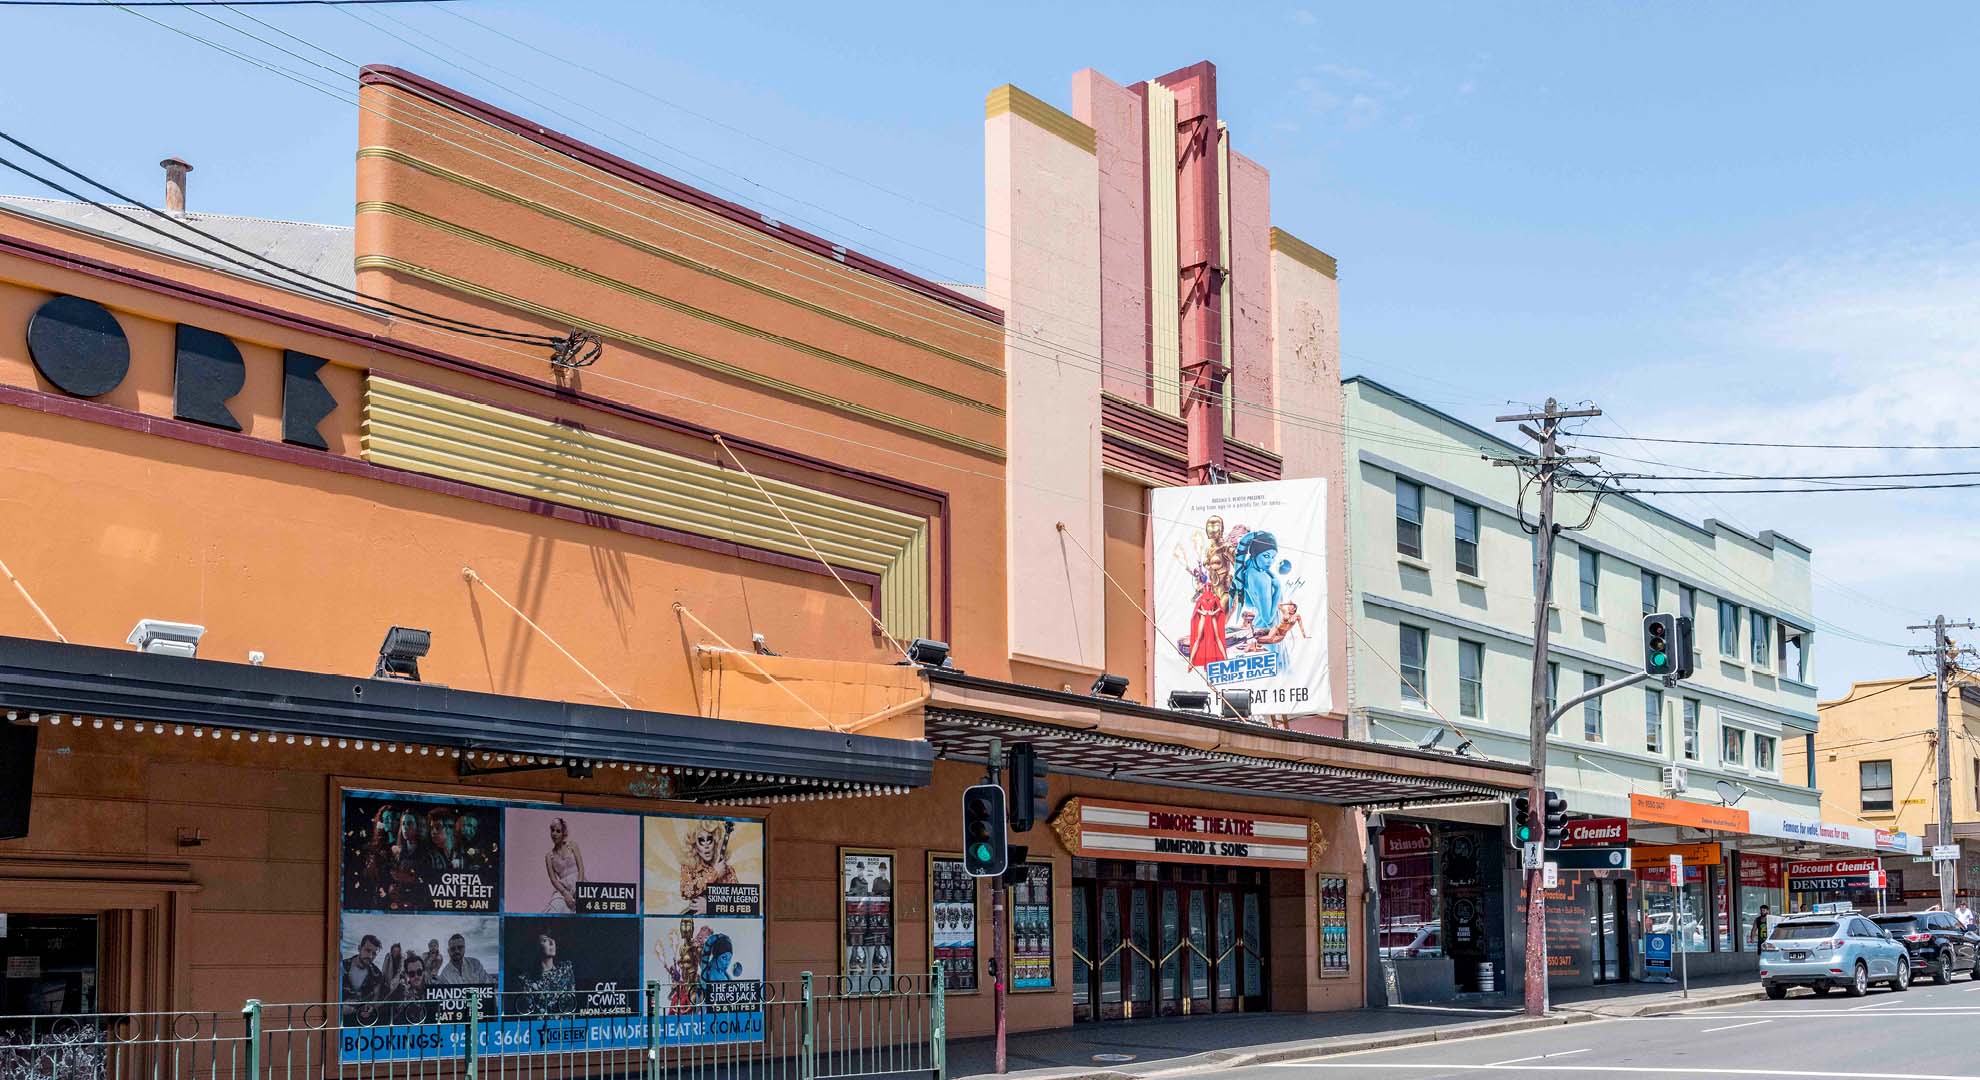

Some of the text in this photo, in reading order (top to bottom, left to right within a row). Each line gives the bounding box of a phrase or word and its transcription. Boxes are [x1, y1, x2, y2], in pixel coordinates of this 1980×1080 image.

[1208, 654, 1275, 677] EMPIRE
[1208, 667, 1277, 684] STRIPS BACK
[1250, 688, 1309, 704] SAT 16 FEB
[1149, 811, 1254, 837] ENMORE THEATRE
[1783, 820, 1799, 833] Famous
[1573, 825, 1622, 840] Chemist
[1155, 837, 1248, 857] MUMFORD & SONS
[1792, 861, 1875, 874] Discount Chemist
[441, 873, 482, 886] GRETA
[1792, 878, 1846, 890] DENTIST
[428, 884, 494, 898] VAN FLEET
[578, 886, 635, 899] LILY ALLEN
[707, 886, 759, 896] TRIXIE MATTEL
[433, 899, 489, 909] TUE 29 JAN
[585, 901, 626, 910] 4 & 5 FEB
[736, 905, 751, 913] FEB
[426, 987, 493, 1000] HANDSIKE
[595, 982, 617, 994] CAT
[711, 983, 726, 992] THE
[710, 992, 735, 1002] STRIPS
[439, 999, 484, 1010] HOUS
[435, 1012, 454, 1021] SAT
[456, 1012, 463, 1021] 9
[344, 1030, 530, 1051] BOOKINGS: 950 3666
